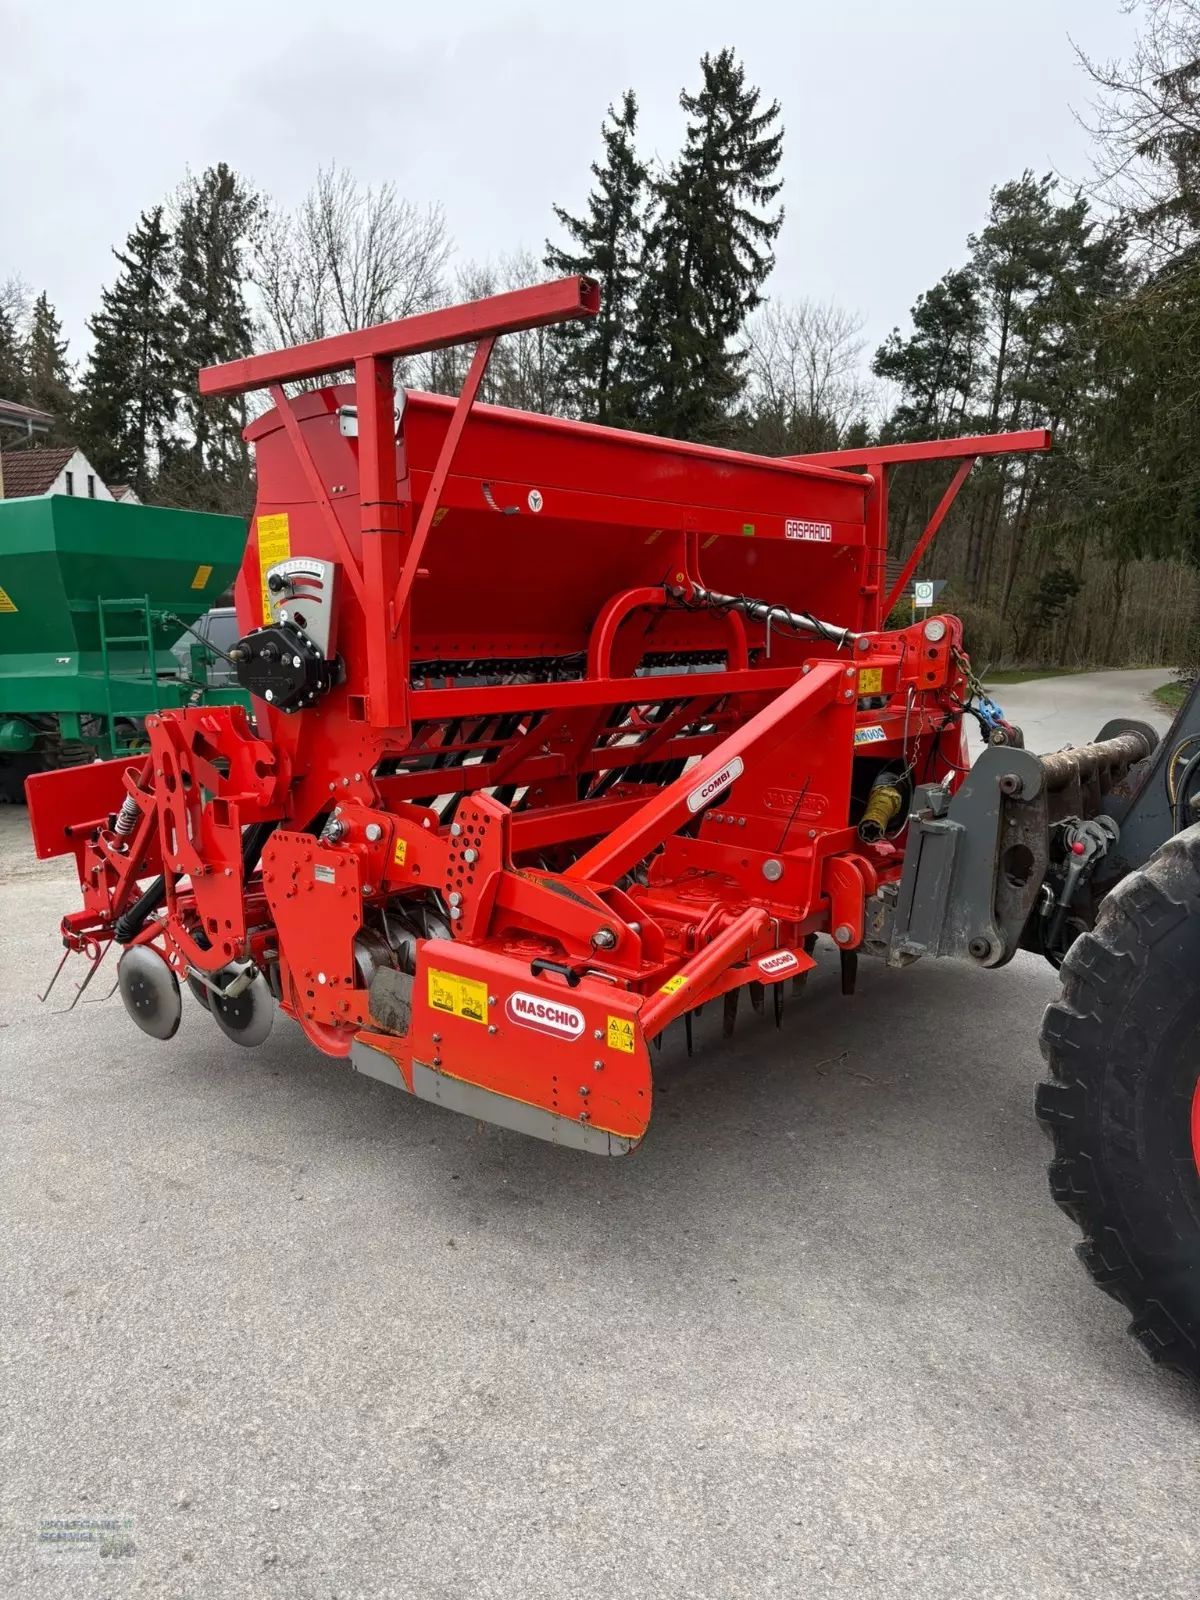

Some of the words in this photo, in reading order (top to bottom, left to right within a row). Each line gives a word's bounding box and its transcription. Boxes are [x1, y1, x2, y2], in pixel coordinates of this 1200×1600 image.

[787, 521, 831, 540] GASPARDO
[701, 770, 731, 798] COMBI
[761, 954, 794, 970] MASCHIO
[515, 998, 580, 1029] MASCHIO
